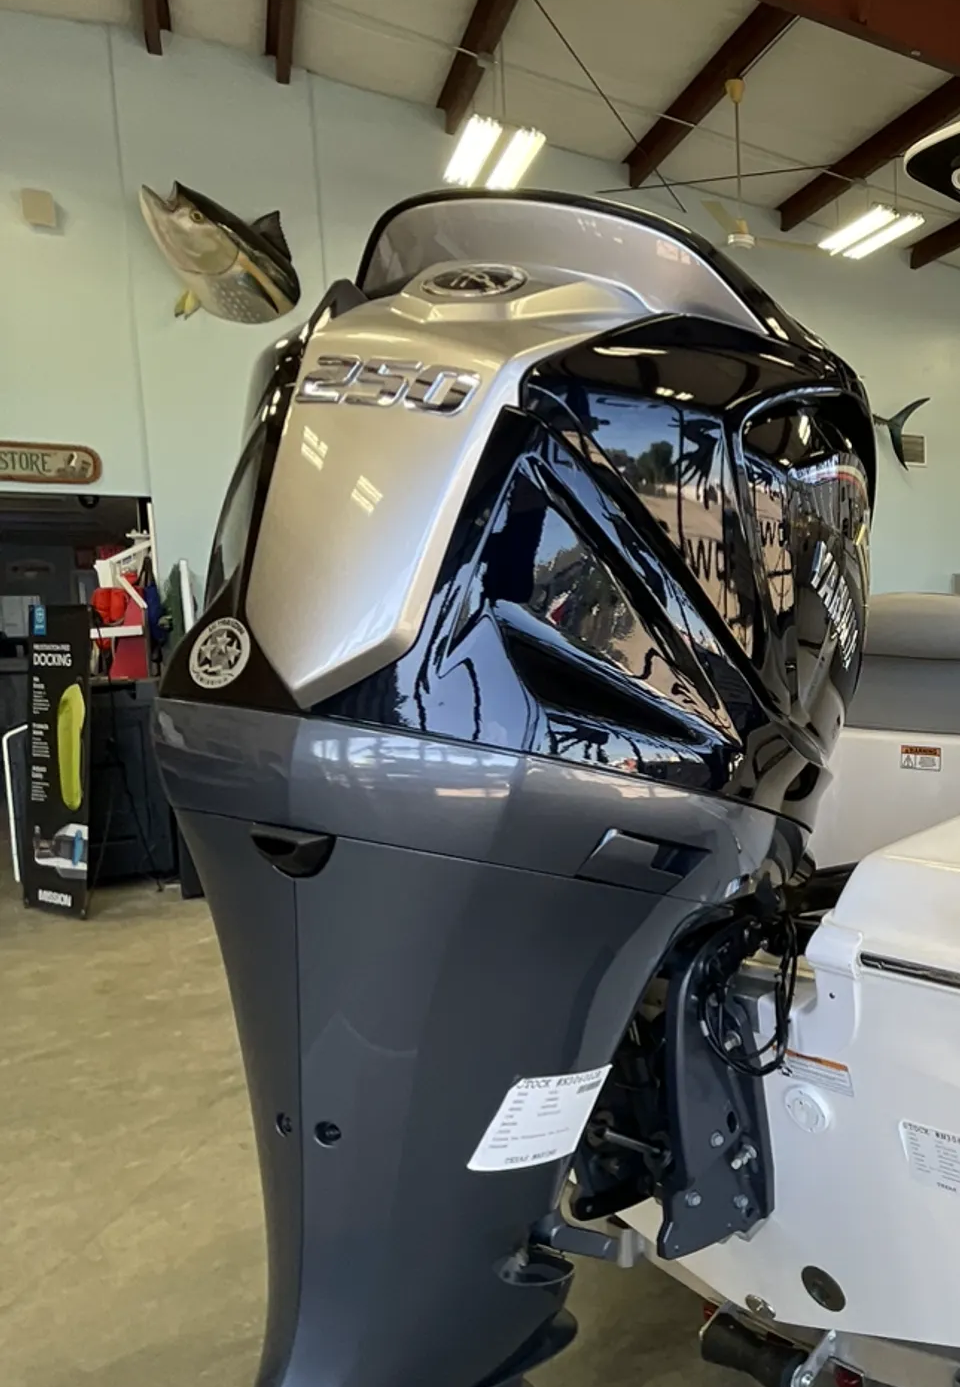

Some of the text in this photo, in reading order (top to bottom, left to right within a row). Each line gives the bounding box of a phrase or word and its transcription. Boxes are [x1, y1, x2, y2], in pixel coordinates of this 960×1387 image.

[295, 355, 481, 417] 250
[0, 451, 52, 477] STORE
[33, 653, 72, 666] DOCKING
[38, 889, 72, 907] MISSION
[902, 1121, 929, 1135] STOCK
